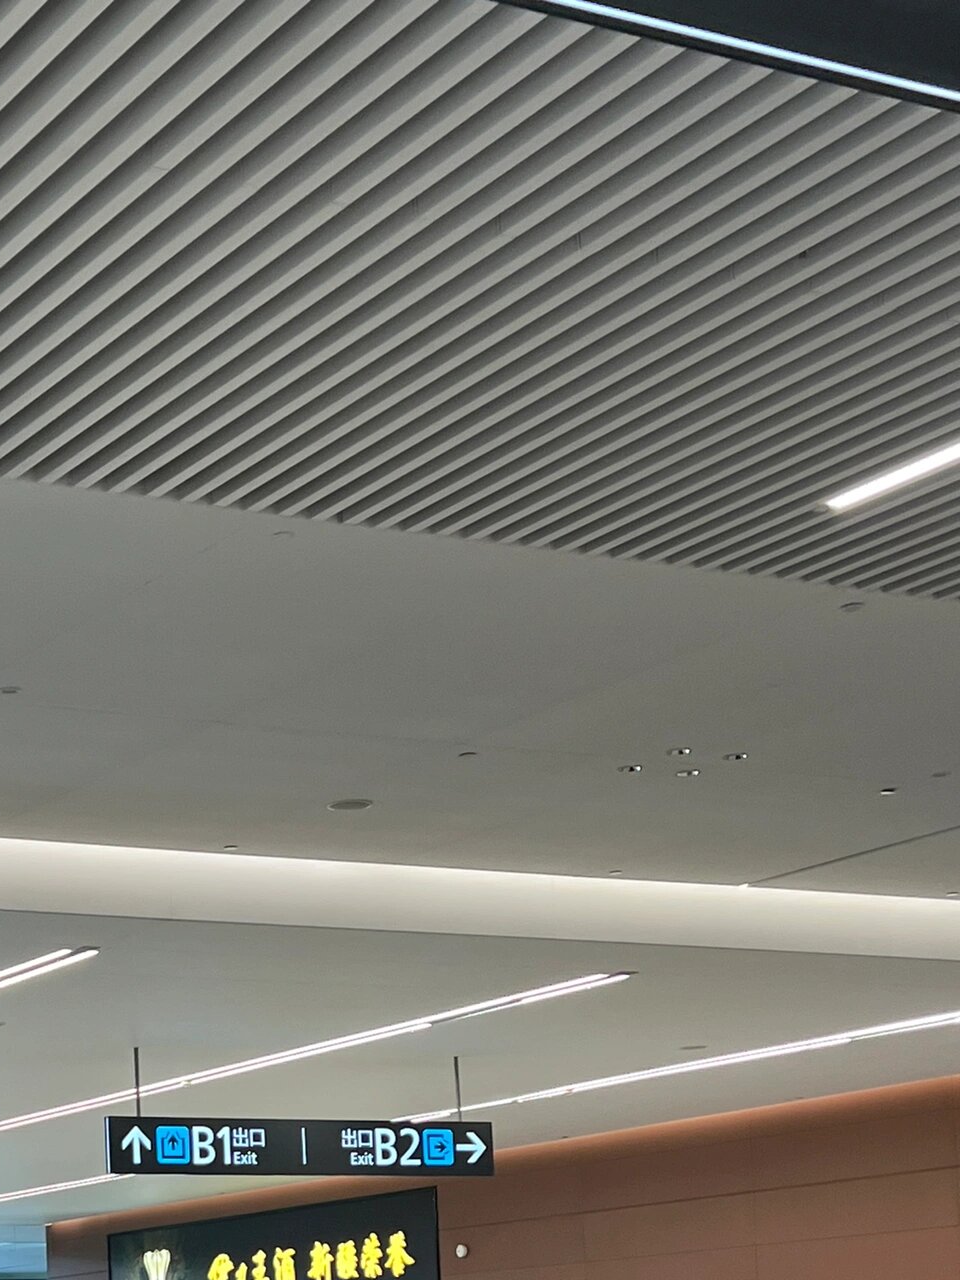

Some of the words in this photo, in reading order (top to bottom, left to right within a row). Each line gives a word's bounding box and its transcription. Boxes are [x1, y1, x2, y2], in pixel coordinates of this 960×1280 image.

[192, 1126, 231, 1166] B1
[233, 1127, 265, 1148] 出口
[233, 1151, 257, 1165] Exit
[342, 1128, 373, 1148] 出口
[375, 1128, 421, 1167] B2
[351, 1152, 374, 1166] Exit
